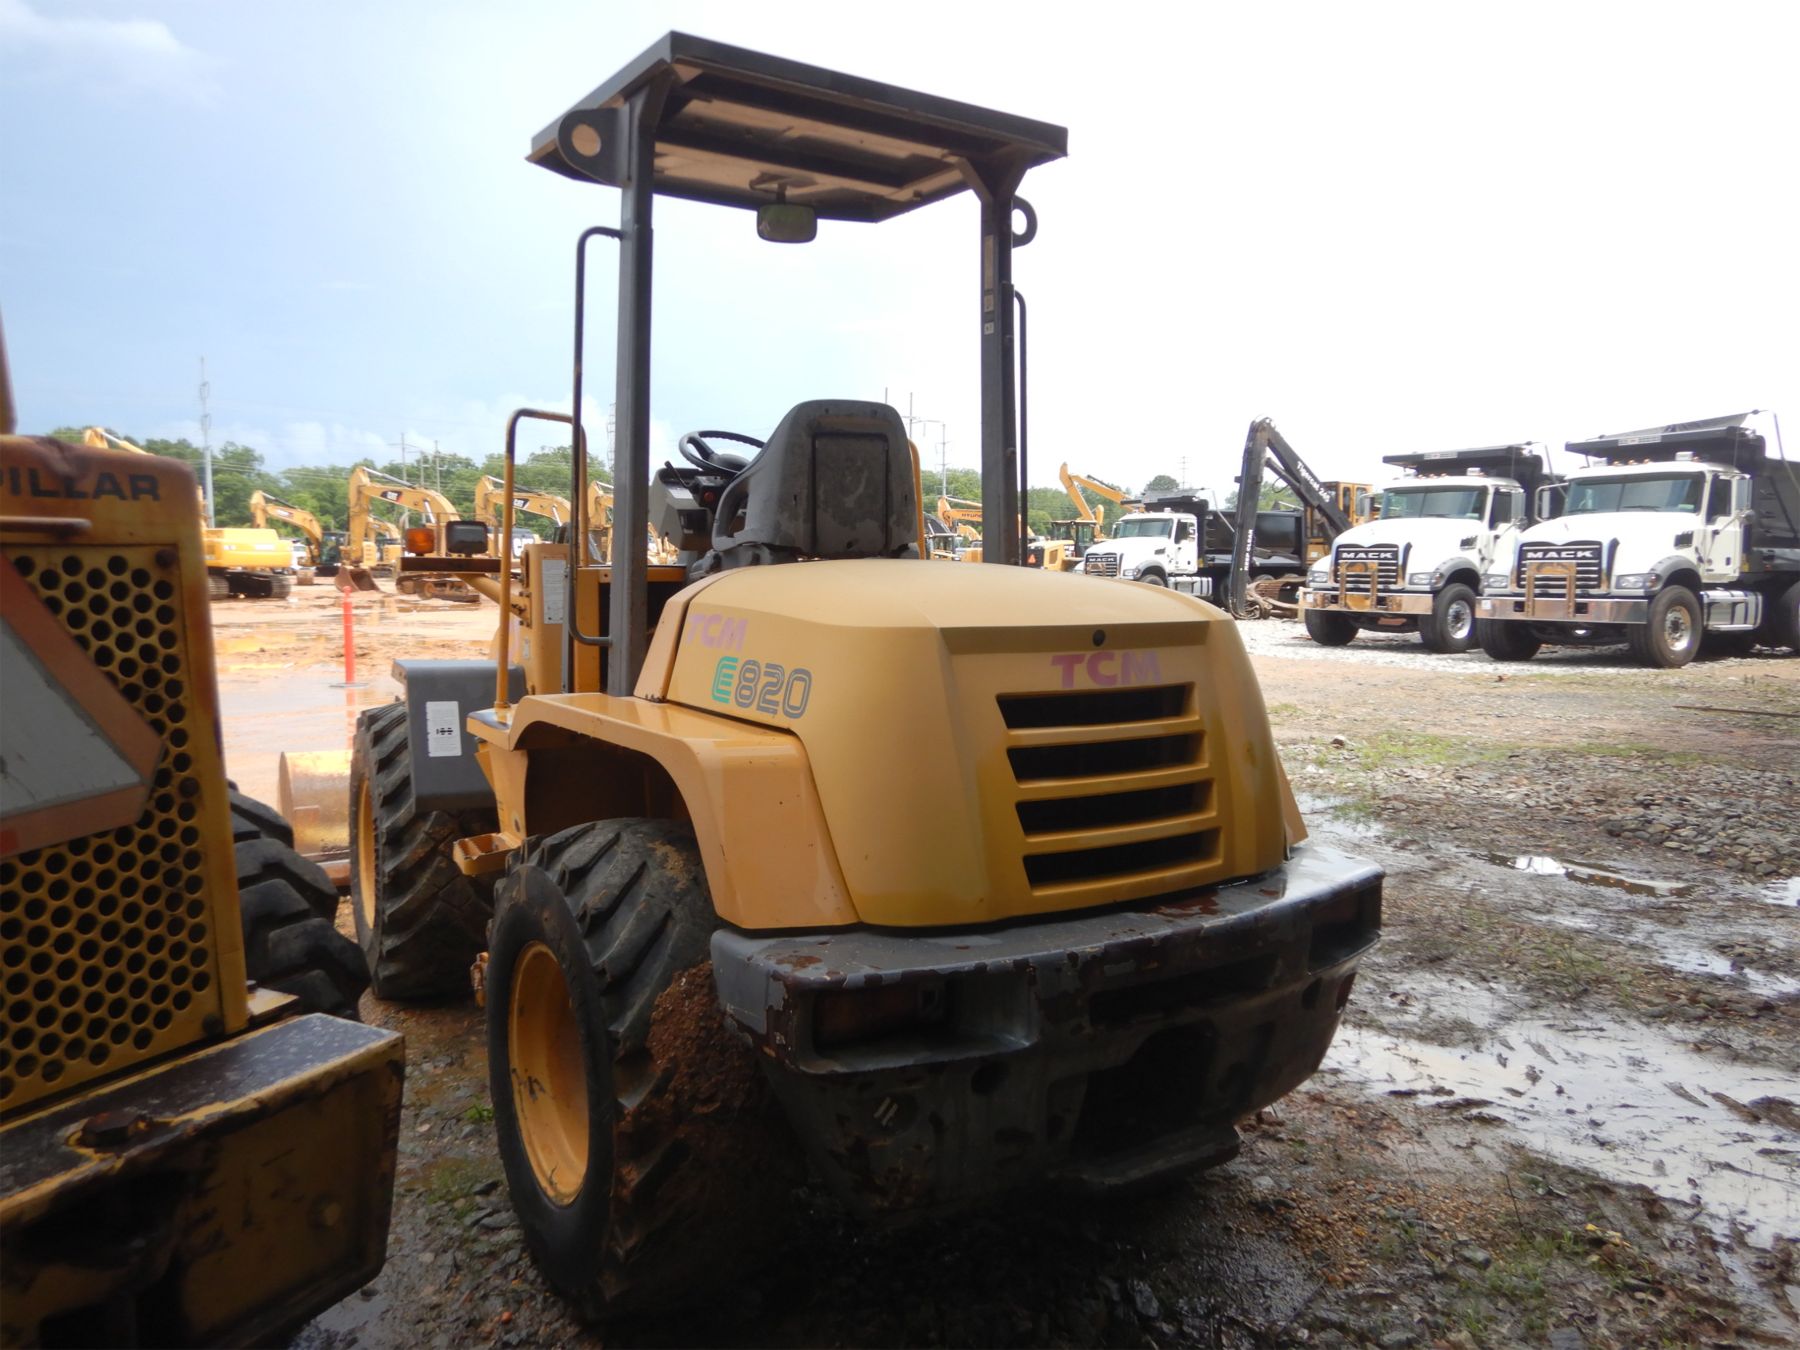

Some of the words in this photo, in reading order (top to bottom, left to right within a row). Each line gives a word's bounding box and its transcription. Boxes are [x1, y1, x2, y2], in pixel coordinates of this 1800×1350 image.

[0, 466, 161, 501] ILLAR
[1526, 551, 1594, 559] MACK
[686, 613, 748, 651] TCM
[711, 656, 812, 719] E820
[1050, 650, 1162, 689] TCM
